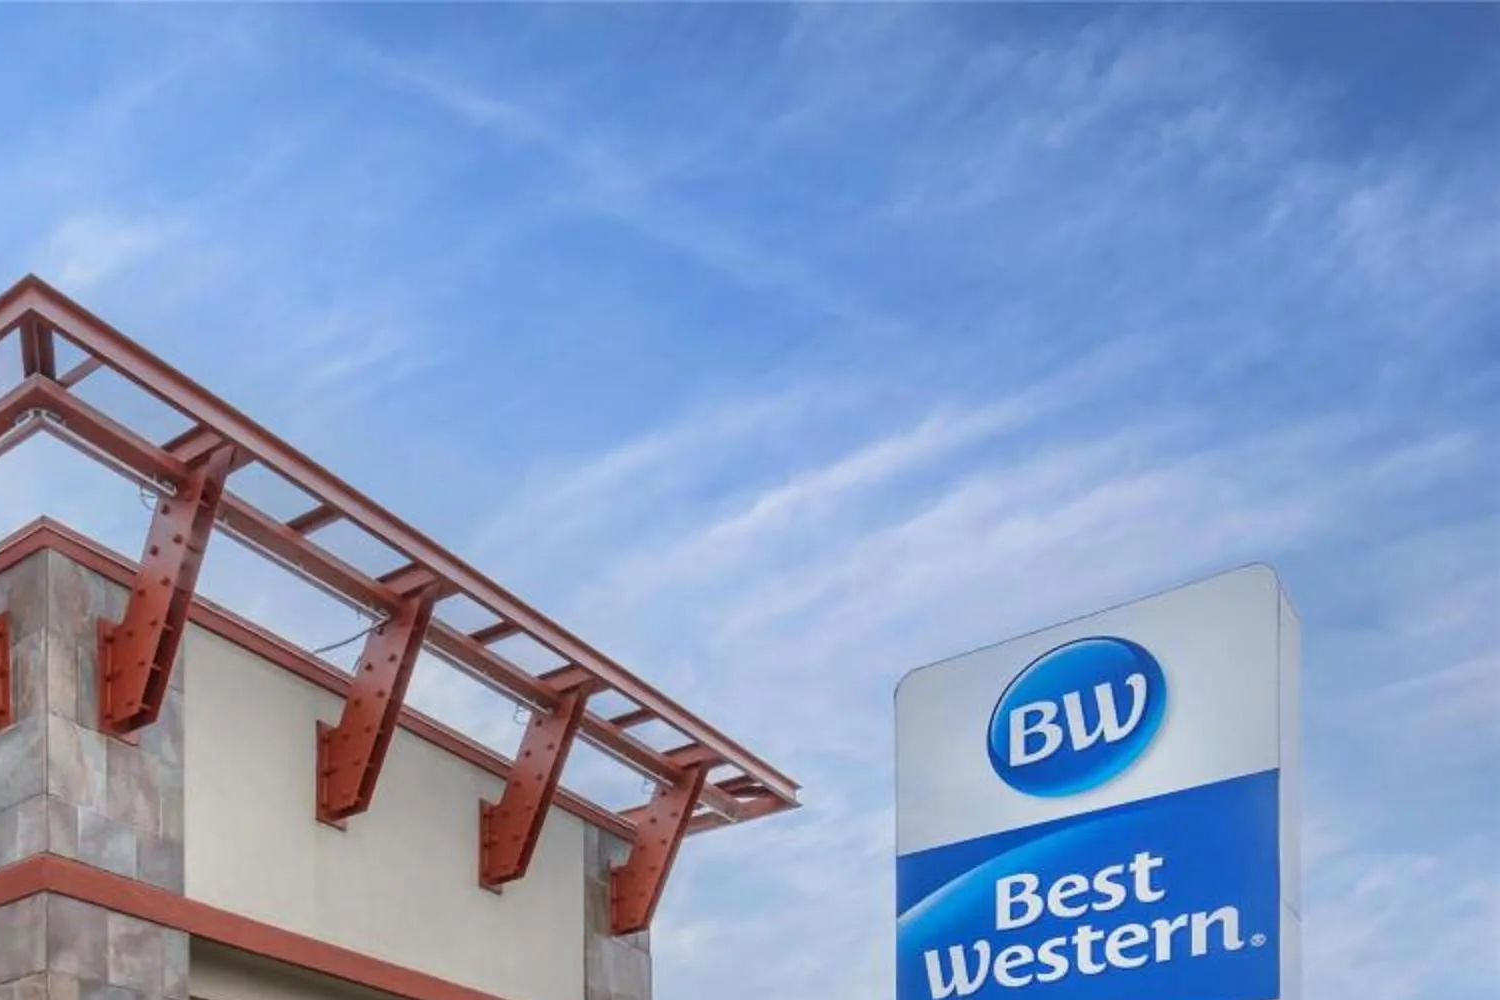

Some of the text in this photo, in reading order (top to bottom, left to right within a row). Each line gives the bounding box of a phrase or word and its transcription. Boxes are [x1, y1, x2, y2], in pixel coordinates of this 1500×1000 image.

[1008, 672, 1148, 767] BW
[995, 851, 1165, 931] Best
[924, 904, 1244, 1000] Western
